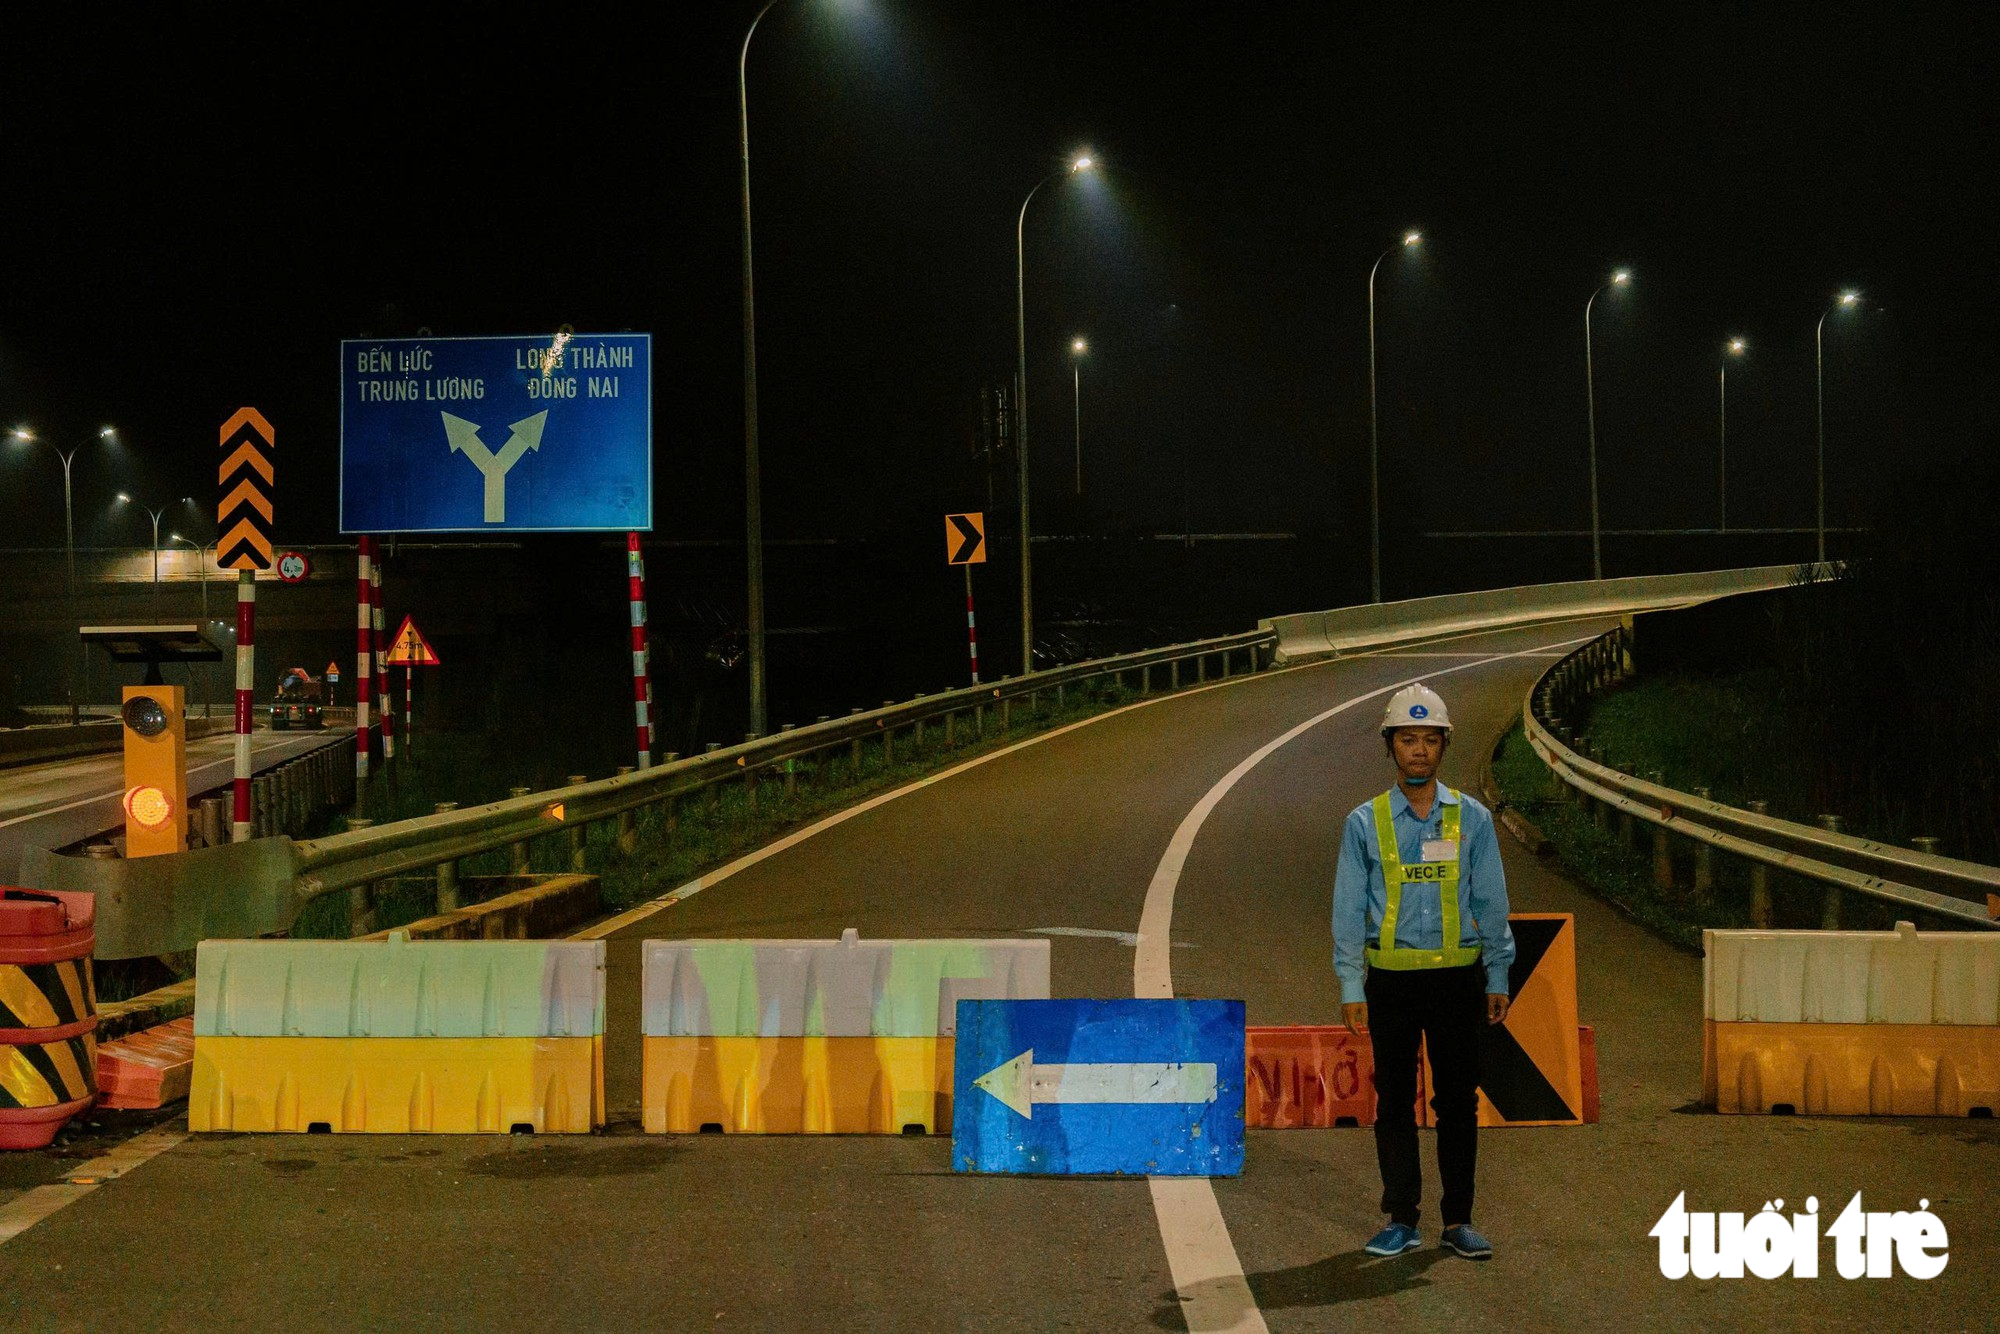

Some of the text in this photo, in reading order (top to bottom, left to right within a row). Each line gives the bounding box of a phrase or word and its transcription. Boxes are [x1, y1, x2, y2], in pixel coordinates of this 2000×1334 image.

[358, 346, 392, 372] BẾN
[571, 342, 633, 369] THÀNH
[358, 377, 484, 401] TRUNG LƯƠNG
[588, 376, 619, 398] NAI
